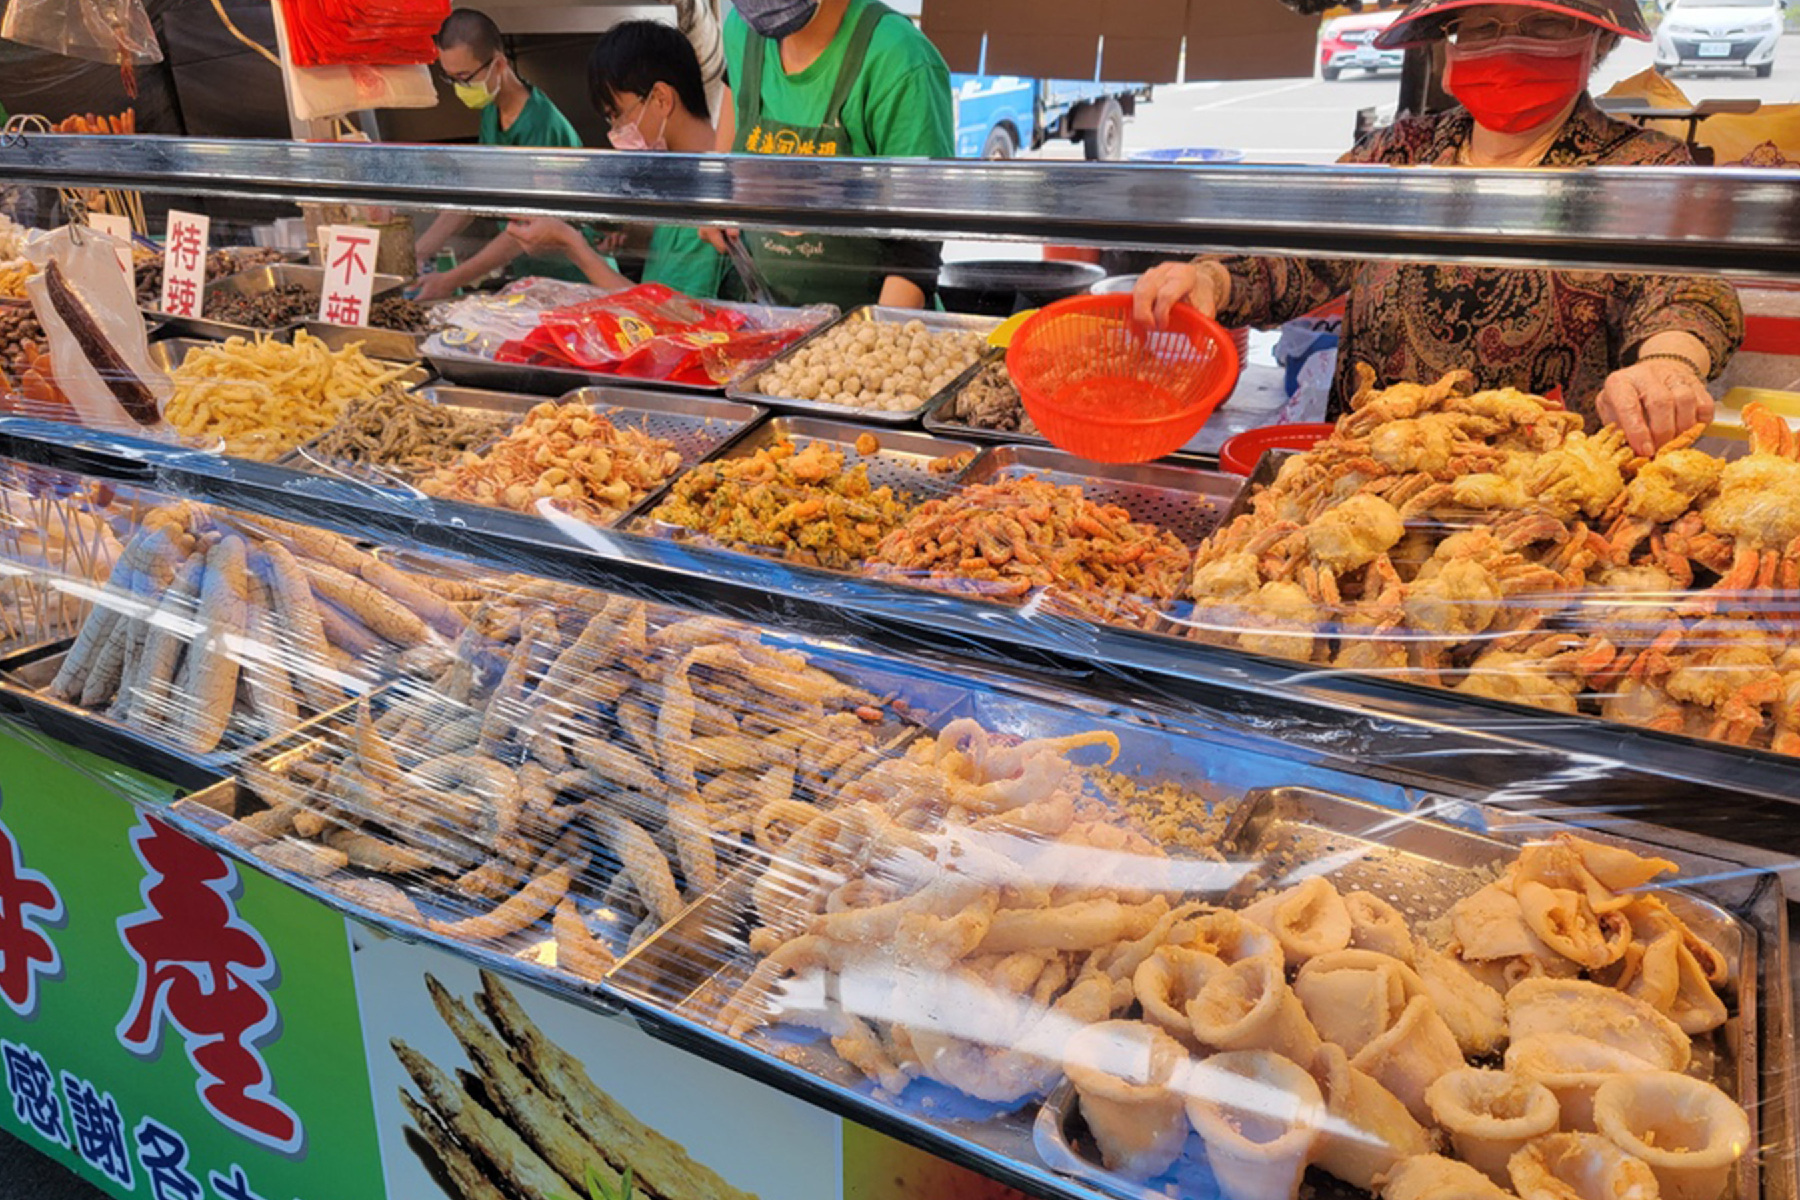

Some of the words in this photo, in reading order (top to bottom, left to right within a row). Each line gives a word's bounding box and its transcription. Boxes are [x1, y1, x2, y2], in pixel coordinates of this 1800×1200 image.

[166, 220, 201, 318] 特辣
[1, 1040, 262, 1200] 感謝各
